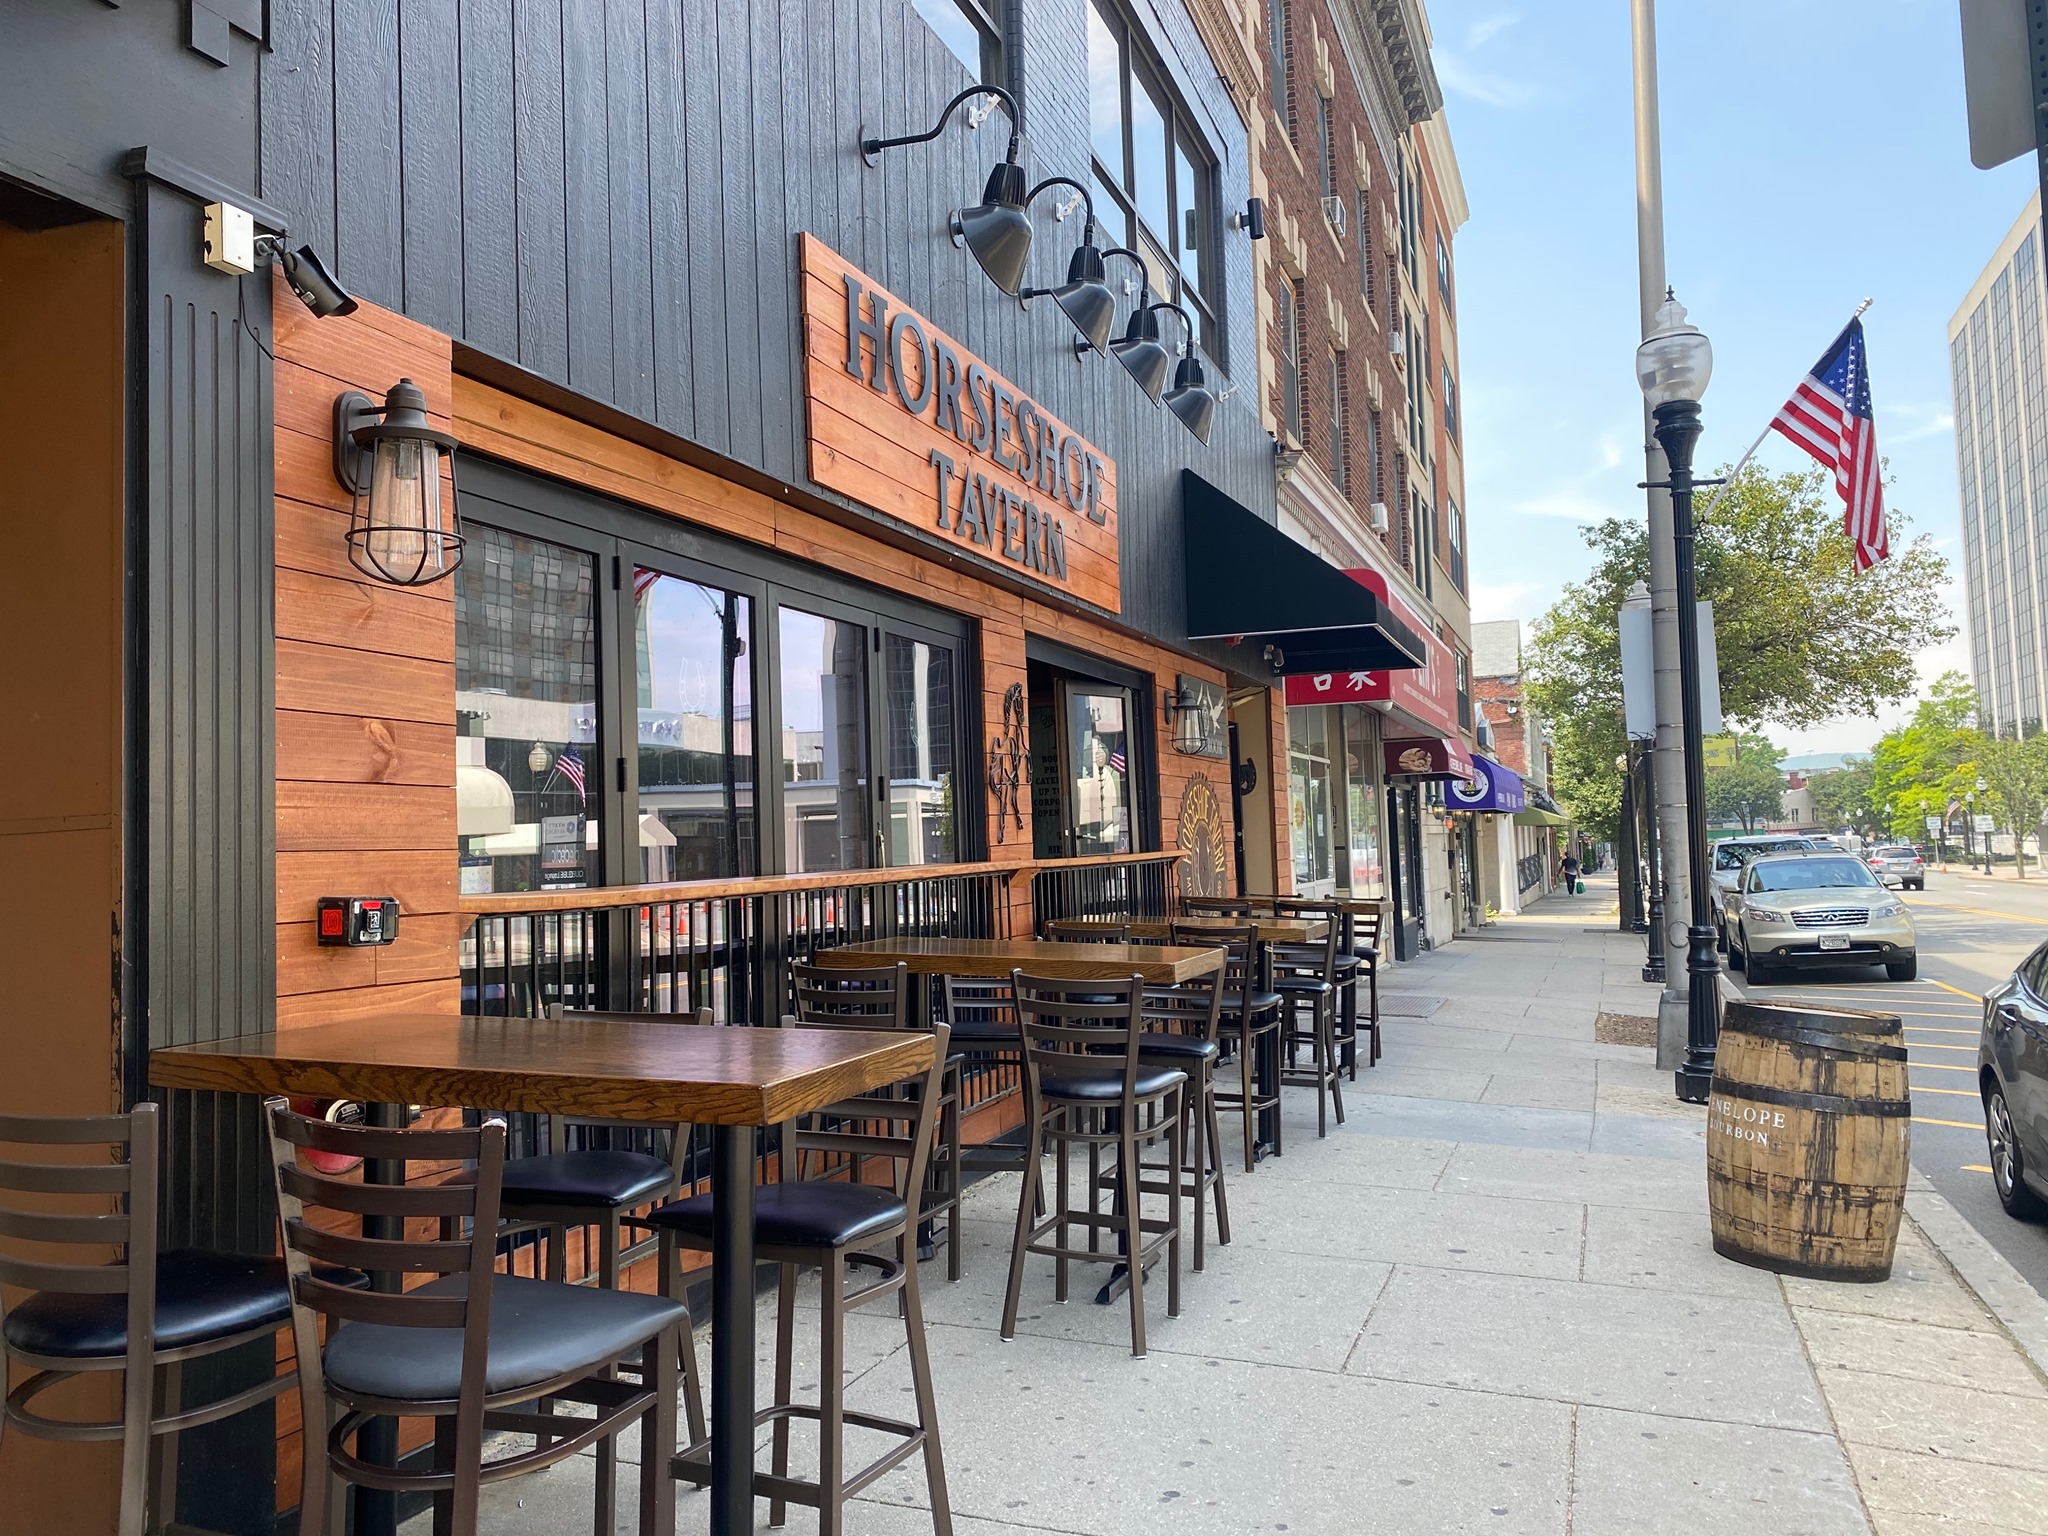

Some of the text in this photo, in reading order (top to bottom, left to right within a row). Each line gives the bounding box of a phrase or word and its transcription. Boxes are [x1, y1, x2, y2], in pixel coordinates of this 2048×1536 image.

[843, 272, 1107, 526] HORSESHOE
[929, 447, 1067, 582] TAVERN
[1709, 1117, 1769, 1148] BOURBON
